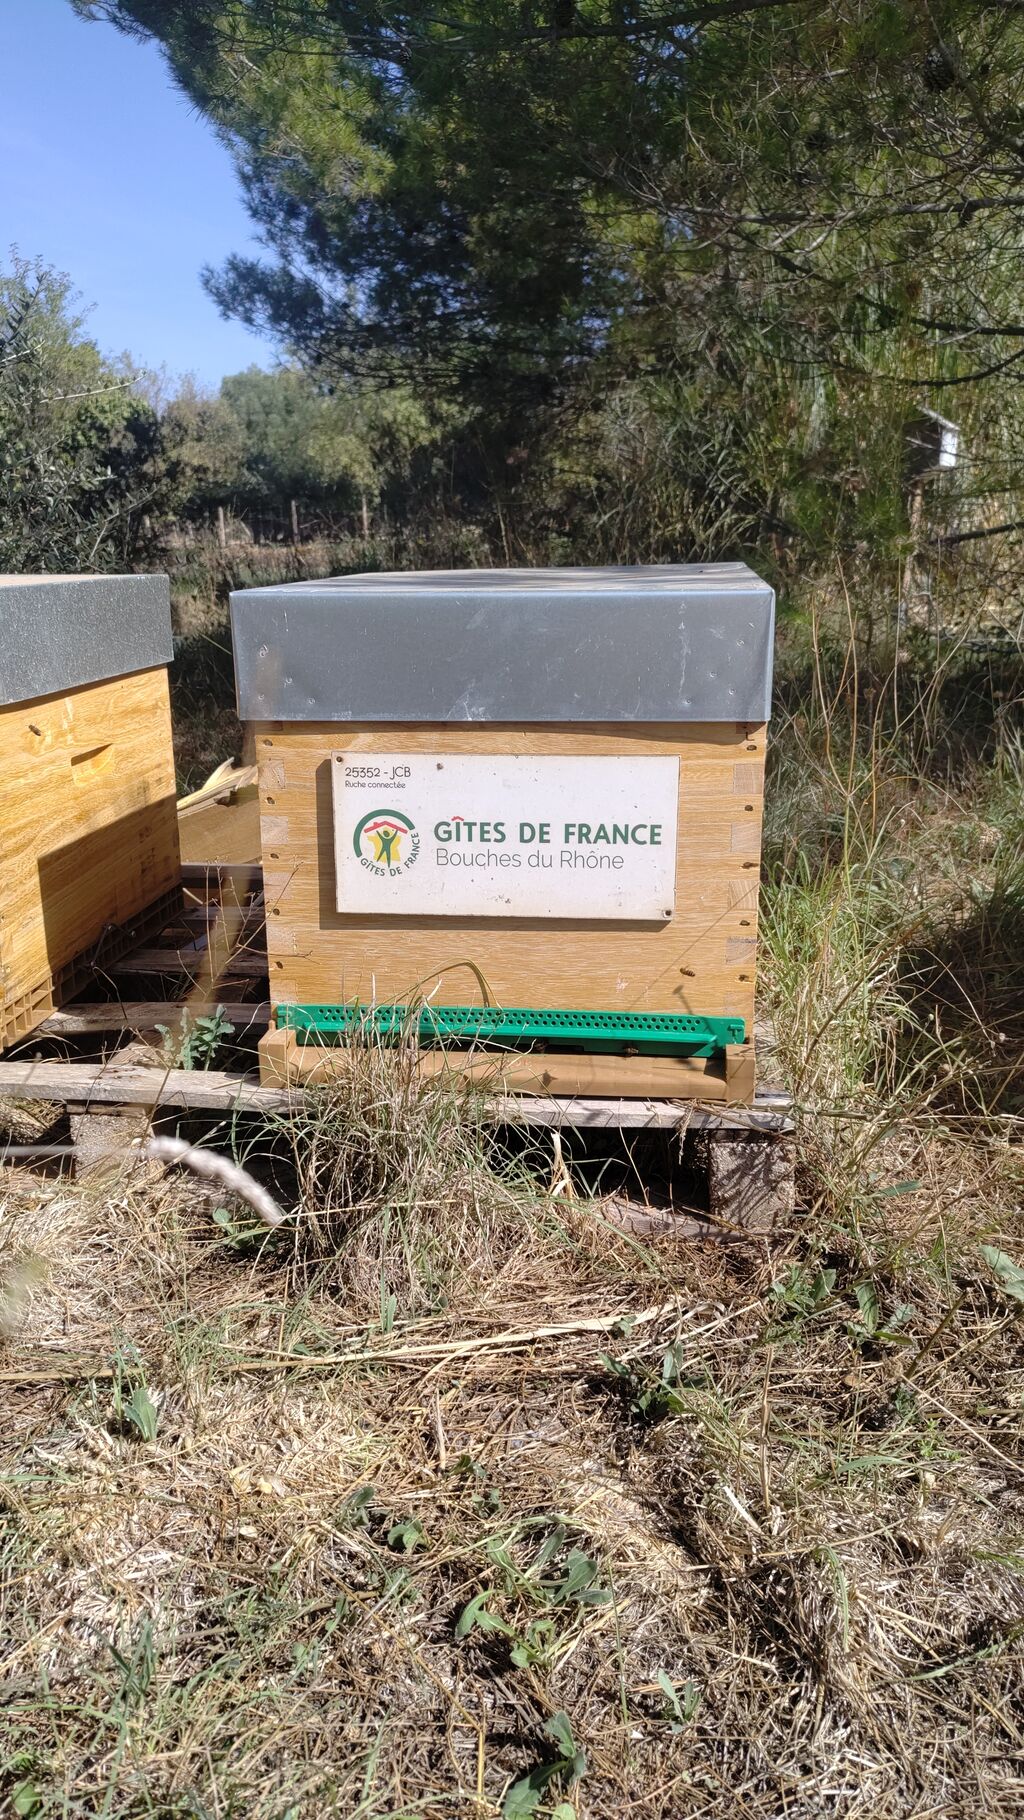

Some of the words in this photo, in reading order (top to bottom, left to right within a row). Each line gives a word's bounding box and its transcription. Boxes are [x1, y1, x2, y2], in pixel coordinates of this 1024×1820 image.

[345, 767, 381, 778] 25352
[390, 766, 411, 780] JCB
[345, 780, 366, 788] Ruche
[367, 780, 406, 789] connectée
[434, 816, 506, 843] GÎTES
[519, 823, 551, 844] DE
[564, 824, 662, 845] FRANCE
[389, 866, 403, 877] DE
[404, 832, 421, 869] FRANCE
[436, 848, 522, 868] Bouches
[528, 849, 553, 869] du
[560, 849, 624, 869] Rhône
